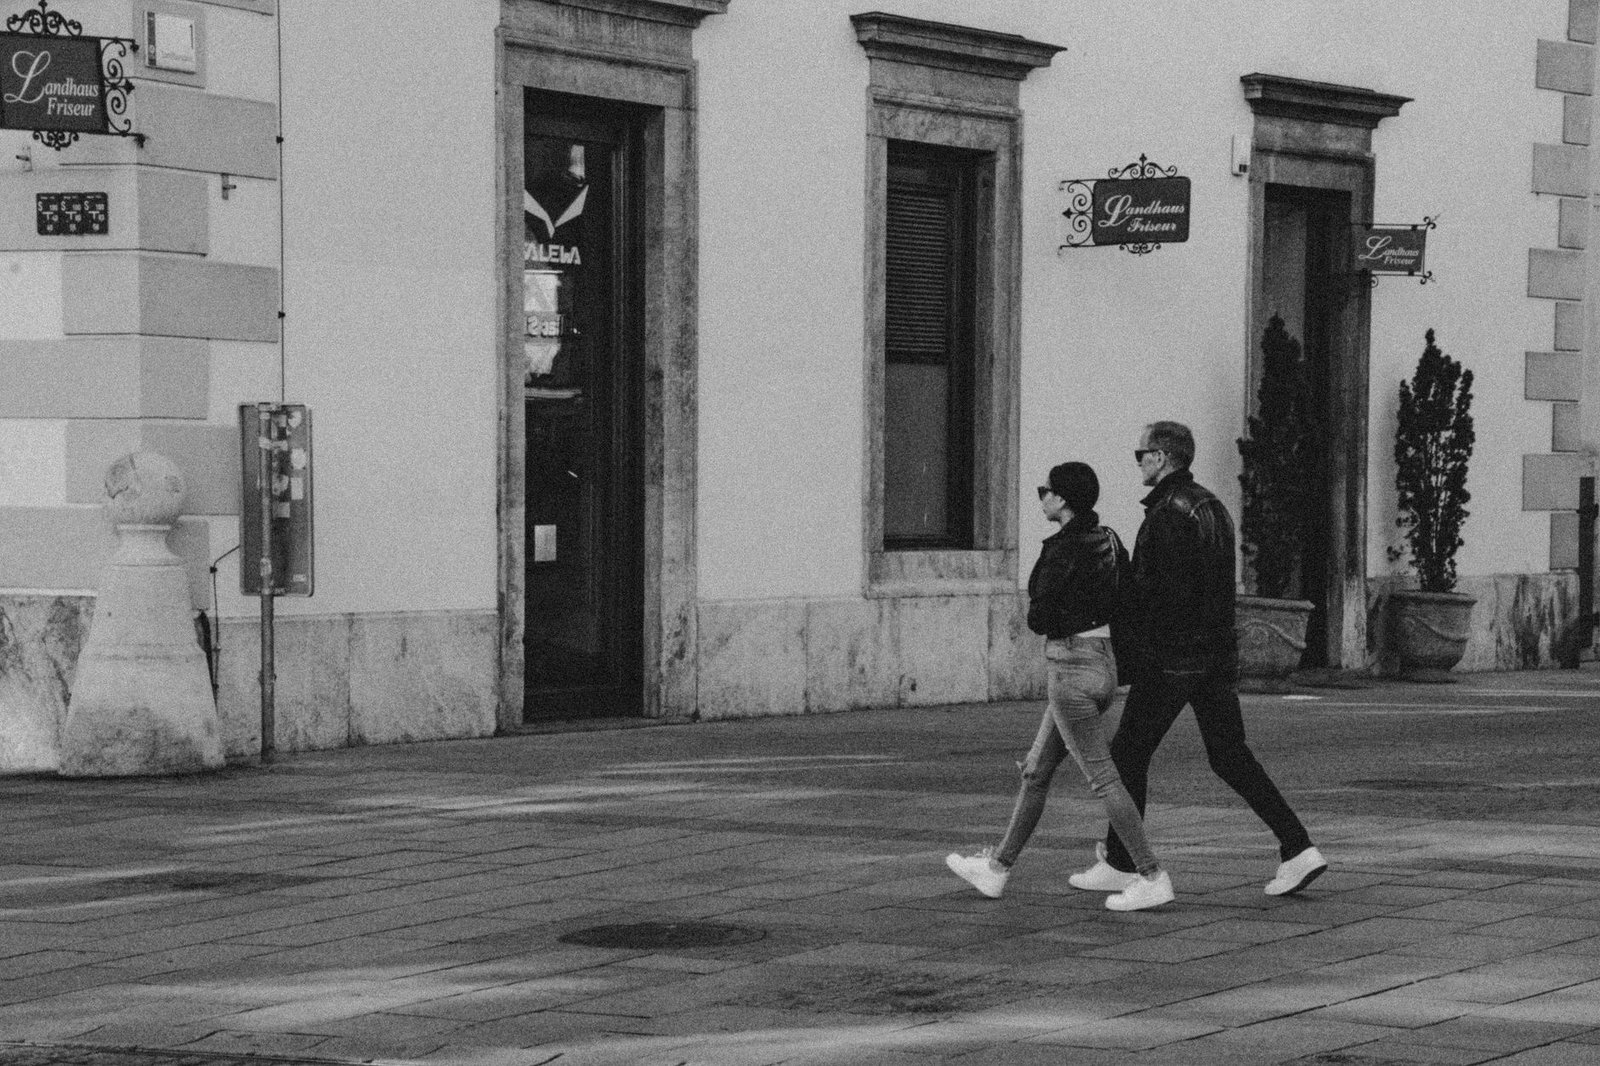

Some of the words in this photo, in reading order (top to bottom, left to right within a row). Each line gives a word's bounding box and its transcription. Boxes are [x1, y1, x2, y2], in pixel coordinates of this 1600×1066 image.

[3, 50, 99, 104] Landhaus
[47, 97, 96, 116] Friseur
[1098, 194, 1185, 227] Landhaus
[1127, 217, 1177, 232] Friseur
[524, 241, 582, 265] ALEWA
[1358, 235, 1420, 260] Landhaus
